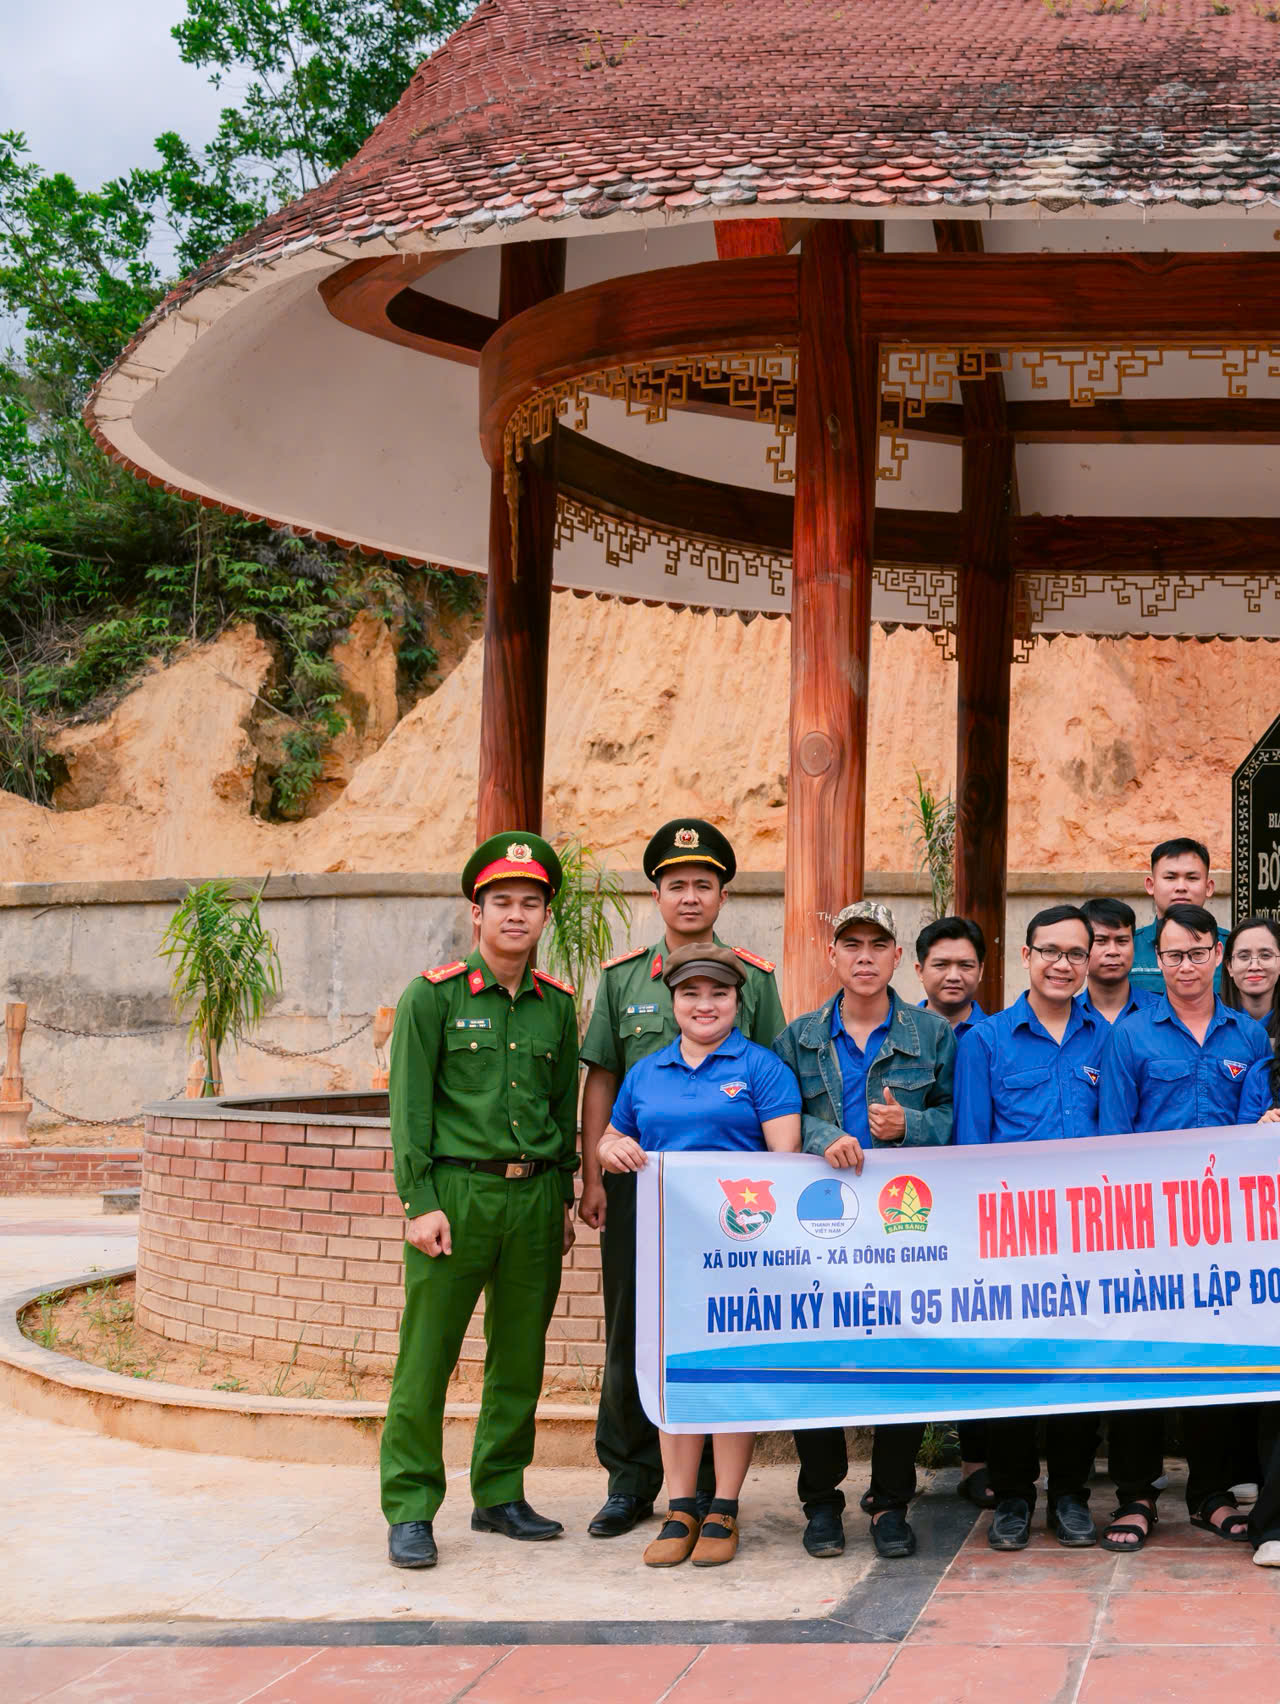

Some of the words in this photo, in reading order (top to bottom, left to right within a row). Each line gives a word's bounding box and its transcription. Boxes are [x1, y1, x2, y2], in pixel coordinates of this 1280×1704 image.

[1258, 840, 1280, 891] BỜ
[978, 1181, 1058, 1259] HÀNH
[1066, 1174, 1155, 1253] TRÌNH
[1162, 1153, 1232, 1247] TUỔI
[703, 1250, 724, 1269] XÃ
[728, 1251, 758, 1268] DUY
[763, 1246, 812, 1266] NGHĨA
[827, 1247, 848, 1264] XÃ
[853, 1245, 896, 1264] ĐÔNG
[901, 1245, 948, 1263] GIANG
[707, 1287, 782, 1333] NHÂN
[791, 1280, 824, 1329] KỶ
[833, 1283, 902, 1335] NIỆM
[911, 1289, 942, 1325] 95
[951, 1278, 1013, 1322] NĂM
[1022, 1273, 1091, 1319] NGÀY
[1099, 1268, 1185, 1314] THÀNH
[1193, 1263, 1241, 1315] LẬP
